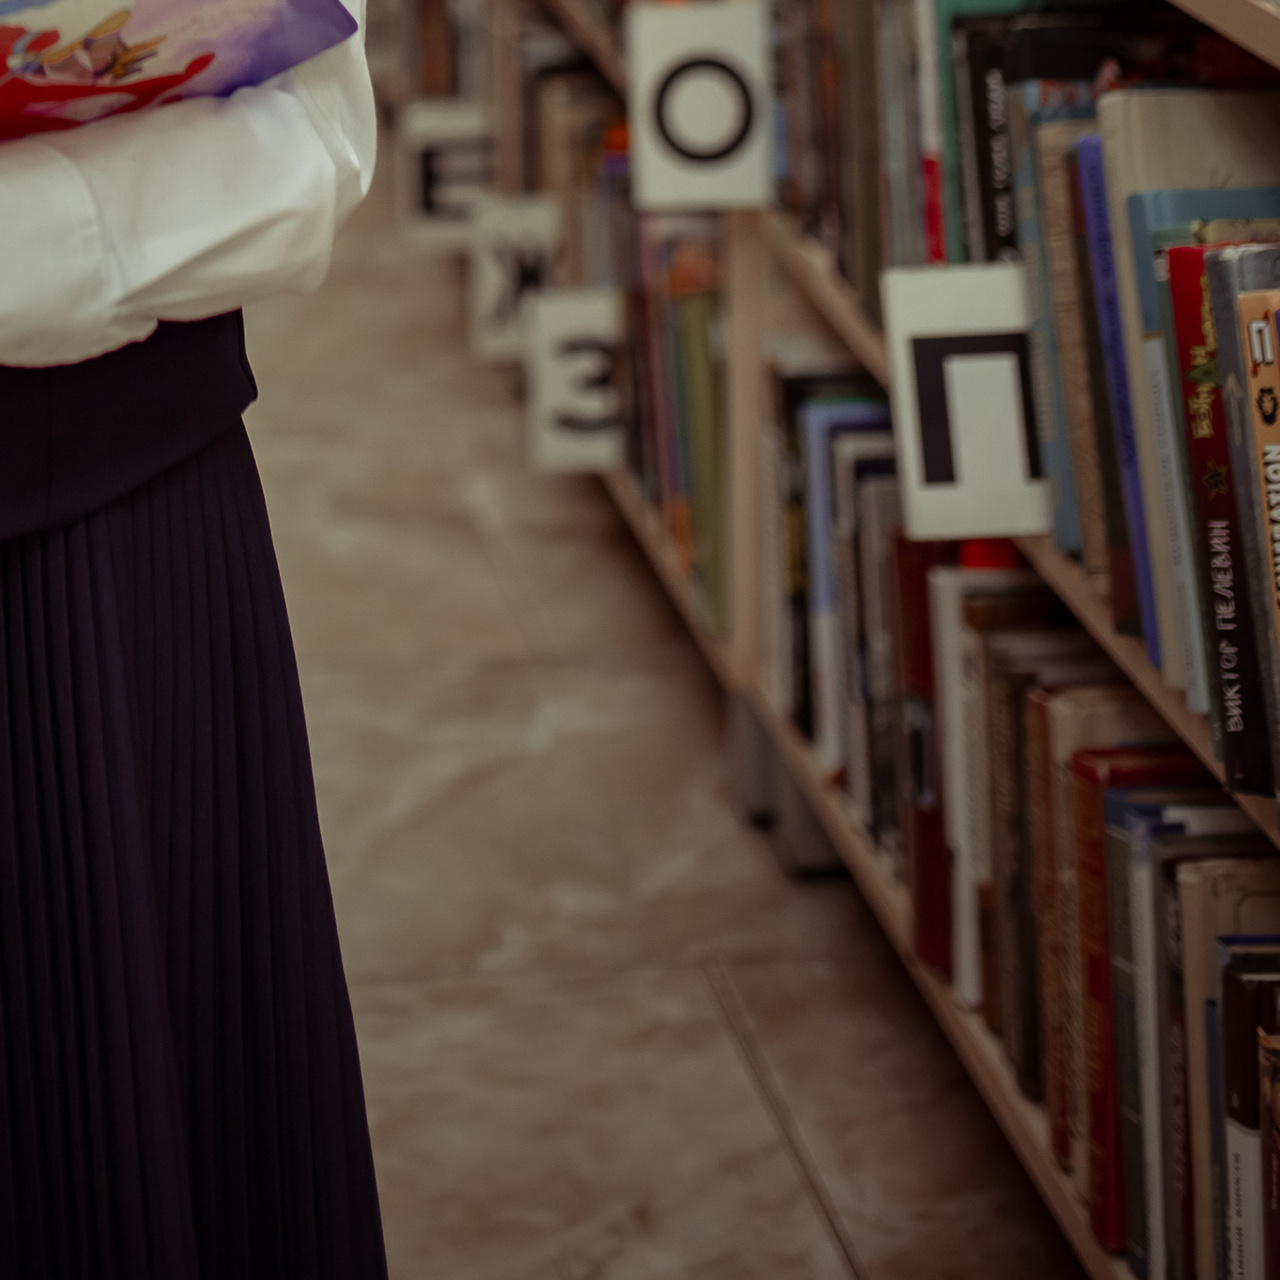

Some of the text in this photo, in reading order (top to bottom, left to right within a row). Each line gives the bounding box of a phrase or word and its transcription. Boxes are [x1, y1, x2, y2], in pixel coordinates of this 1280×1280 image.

[653, 56, 756, 164] О
[911, 332, 1044, 484] П
[1207, 519, 1246, 734] ВИКТОР ПЕЛЕВИН
